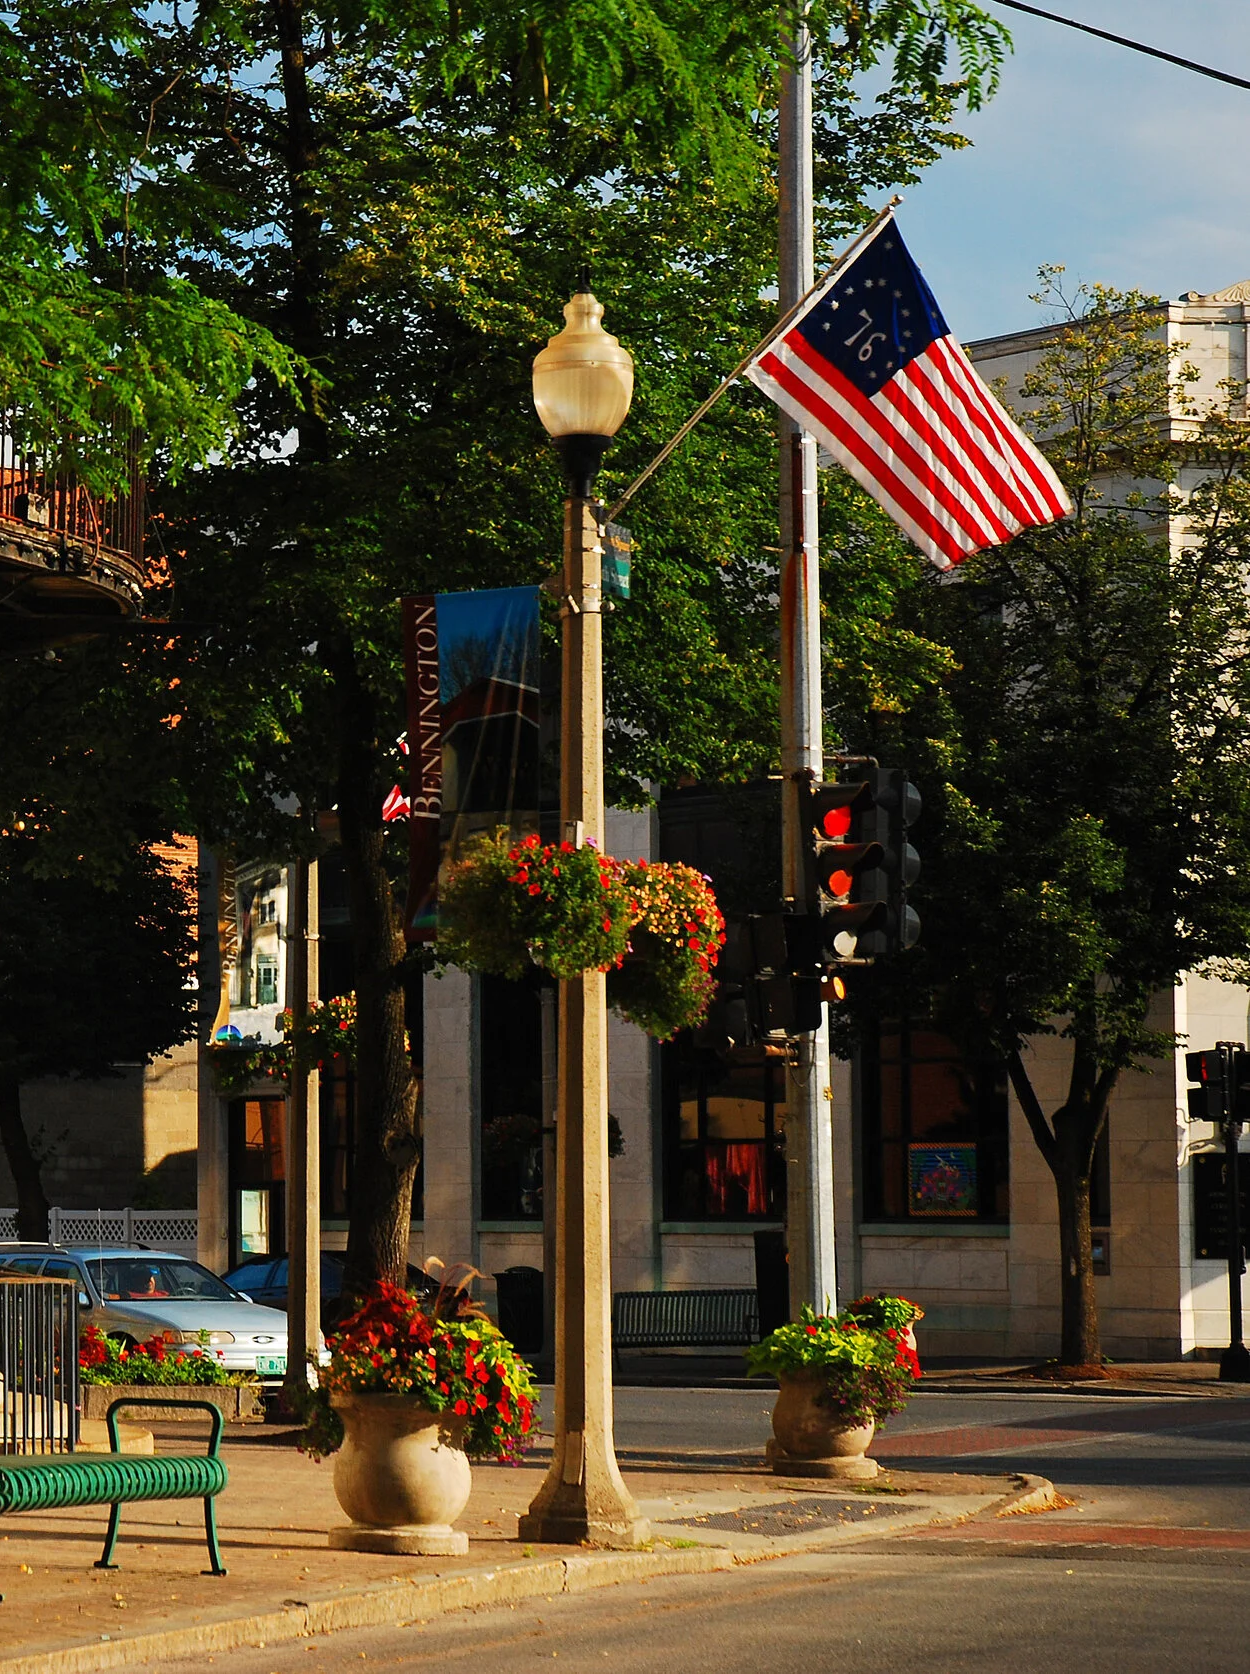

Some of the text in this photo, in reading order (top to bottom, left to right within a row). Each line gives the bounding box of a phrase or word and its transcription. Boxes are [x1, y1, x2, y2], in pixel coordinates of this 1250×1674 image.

[844, 308, 887, 363] 76
[413, 604, 442, 820] BENNINGTON
[221, 858, 239, 973] BENNINGTO
